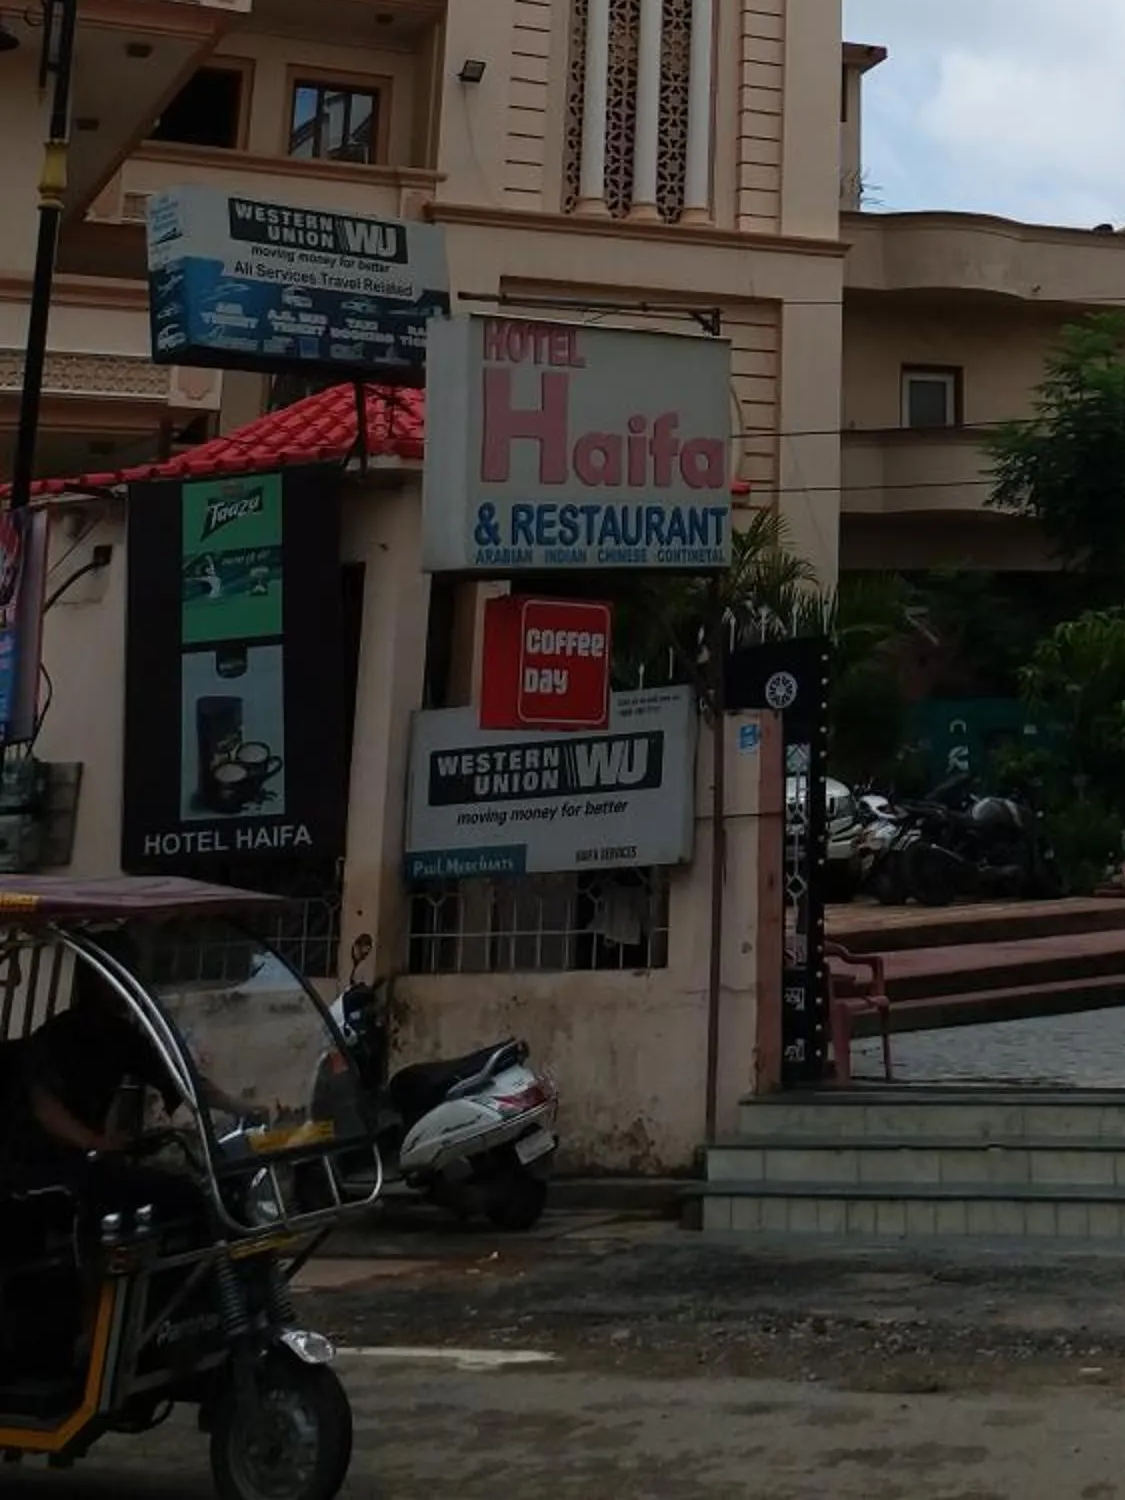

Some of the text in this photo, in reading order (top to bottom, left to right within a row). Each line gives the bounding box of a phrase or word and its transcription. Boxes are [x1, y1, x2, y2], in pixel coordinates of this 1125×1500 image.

[235, 199, 335, 231] WESTERN
[266, 227, 335, 250] UNION
[343, 219, 398, 258] WU
[234, 260, 253, 277] All
[256, 263, 317, 286] Services
[320, 272, 362, 291] Travel
[251, 245, 391, 274] moving money for better
[483, 320, 586, 368] HOTEL
[480, 367, 727, 489] Haifa
[474, 502, 729, 547] & RESTAURANT
[544, 548, 588, 564] INDIAN
[597, 548, 648, 564] CHINESE
[437, 746, 561, 778] WESTERN
[575, 738, 650, 789] WU
[473, 769, 561, 797] UNION
[457, 799, 628, 826] moving money for better
[143, 823, 314, 856] HOTEL HAIFA
